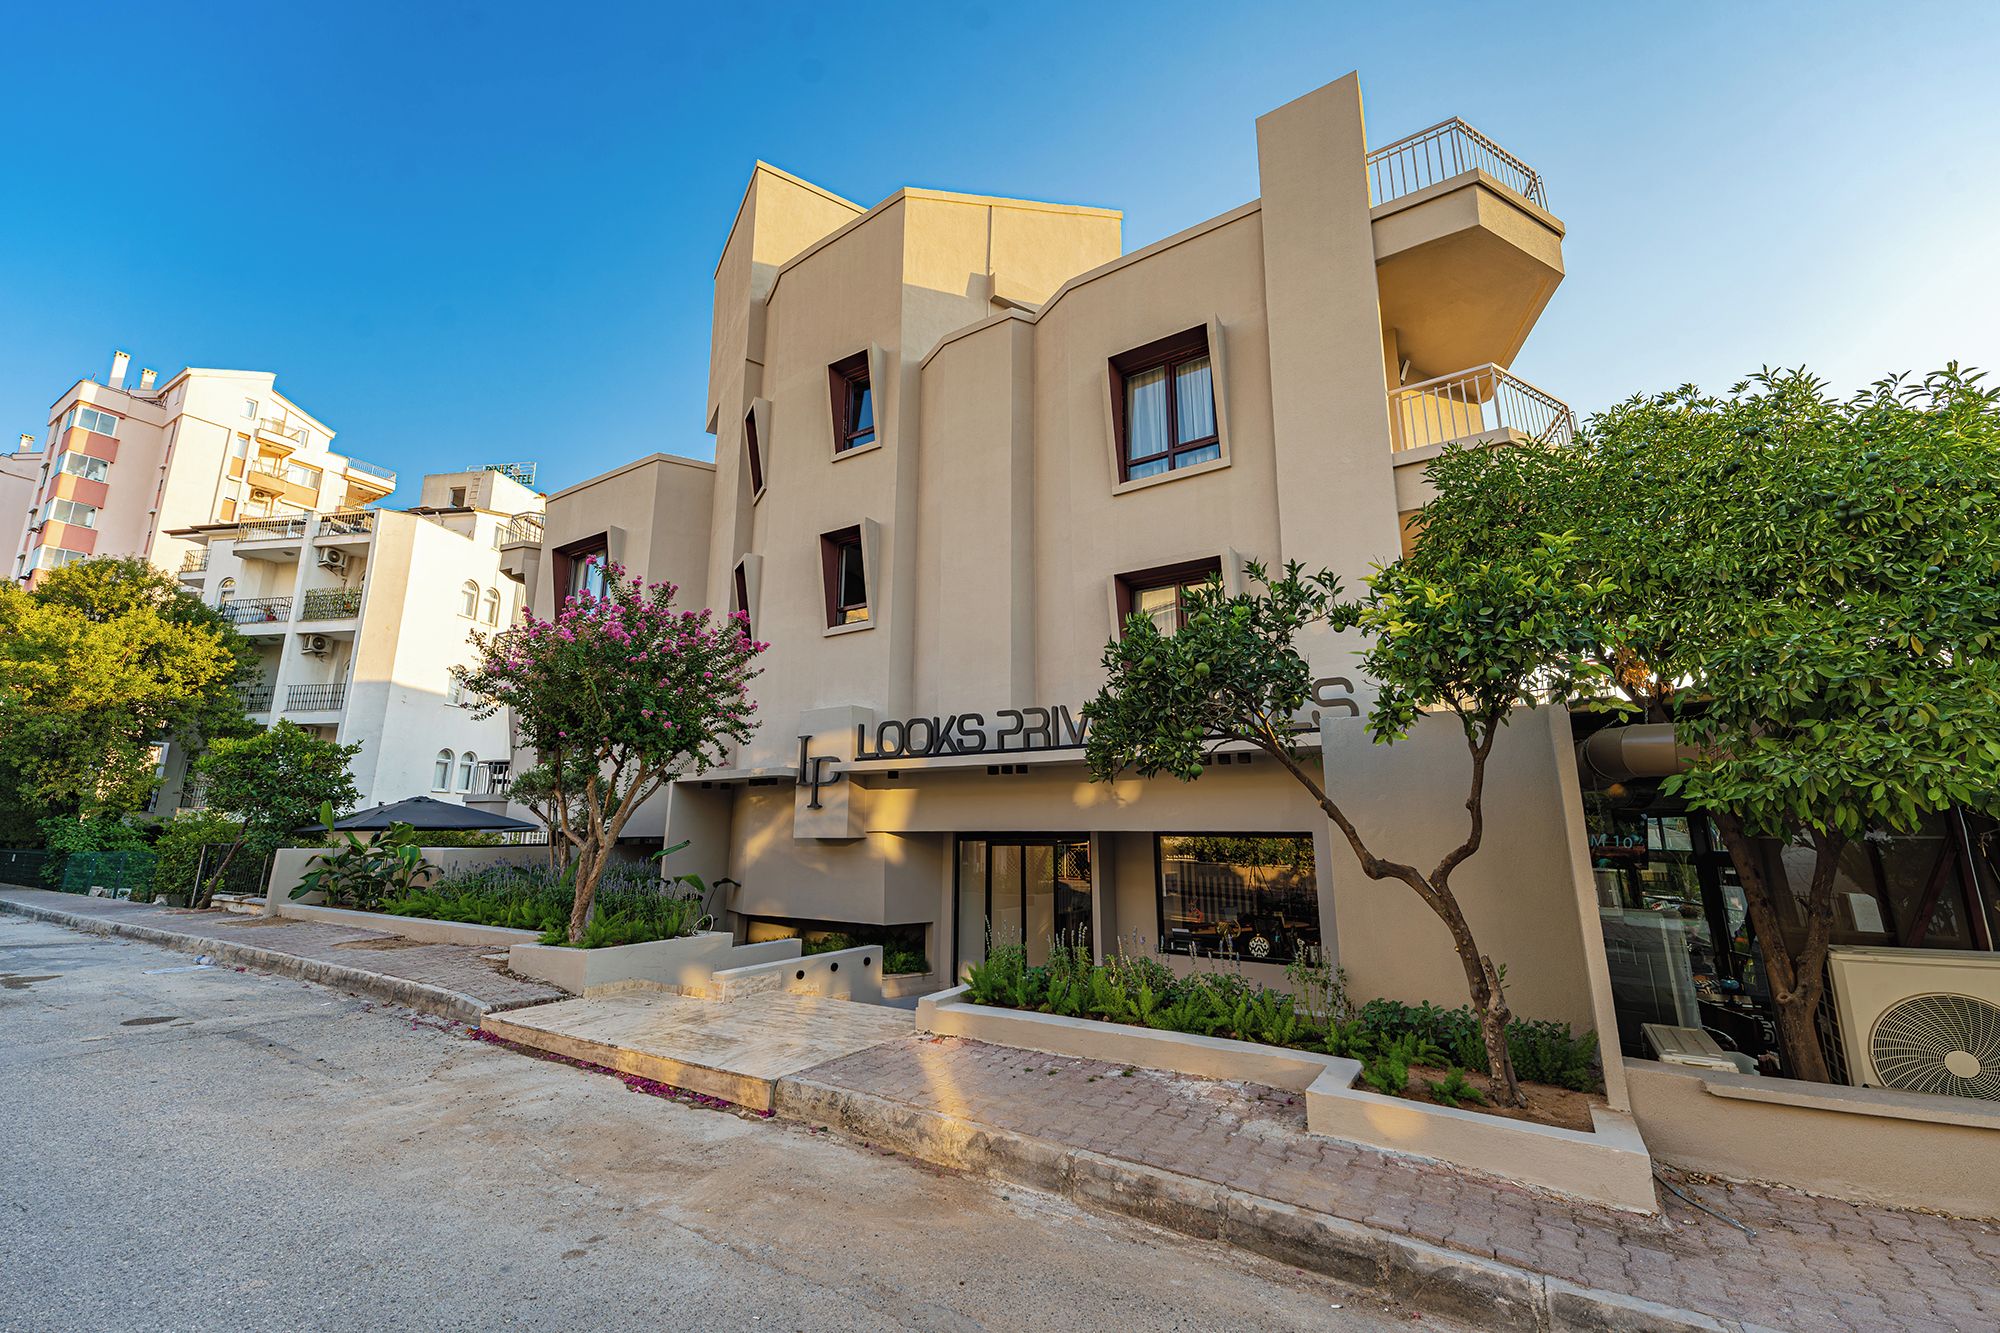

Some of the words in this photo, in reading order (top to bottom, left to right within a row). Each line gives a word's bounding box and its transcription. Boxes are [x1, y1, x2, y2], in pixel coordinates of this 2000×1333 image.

[508, 474, 533, 485] OTEL
[857, 713, 986, 757] LOOKS
[996, 705, 1090, 751] PRIV
